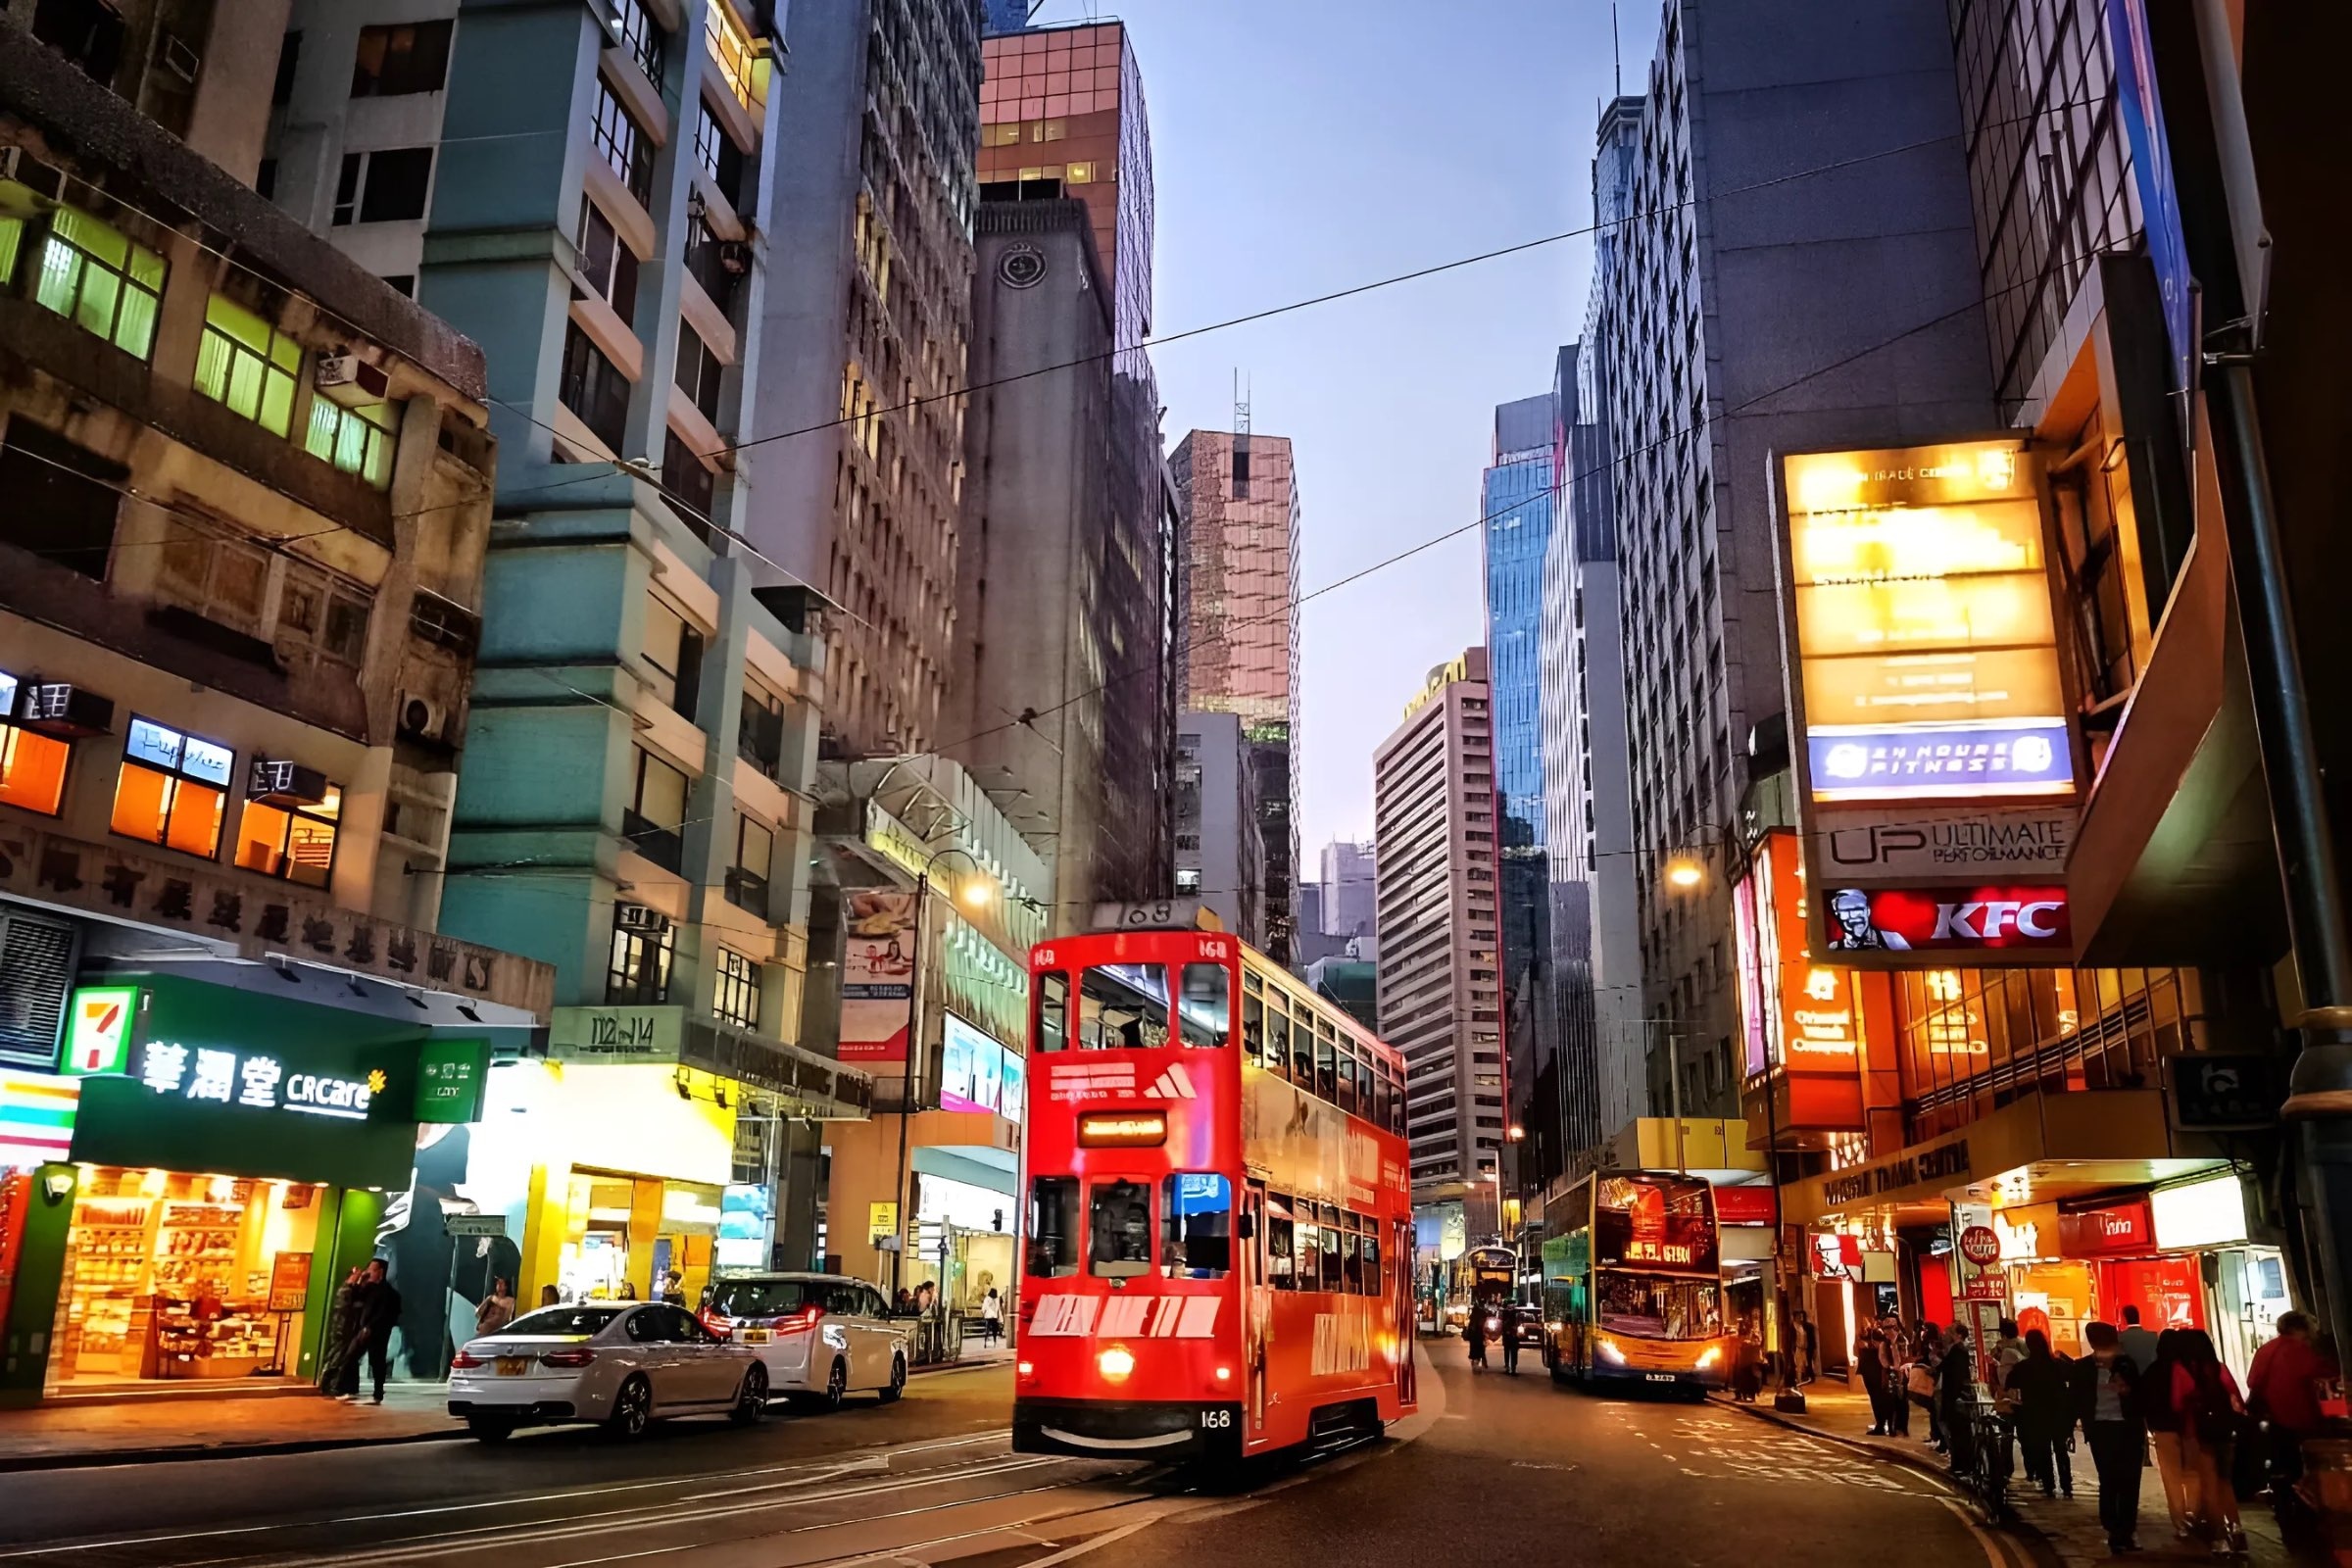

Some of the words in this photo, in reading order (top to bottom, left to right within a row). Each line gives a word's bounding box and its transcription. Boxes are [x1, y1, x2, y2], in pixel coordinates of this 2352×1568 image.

[1830, 826, 1928, 865] UP
[1932, 820, 2067, 849] ULTIMATE
[1930, 901, 2066, 939] KFC
[1199, 939, 1227, 958] 168
[1201, 1409, 1231, 1429] 168
